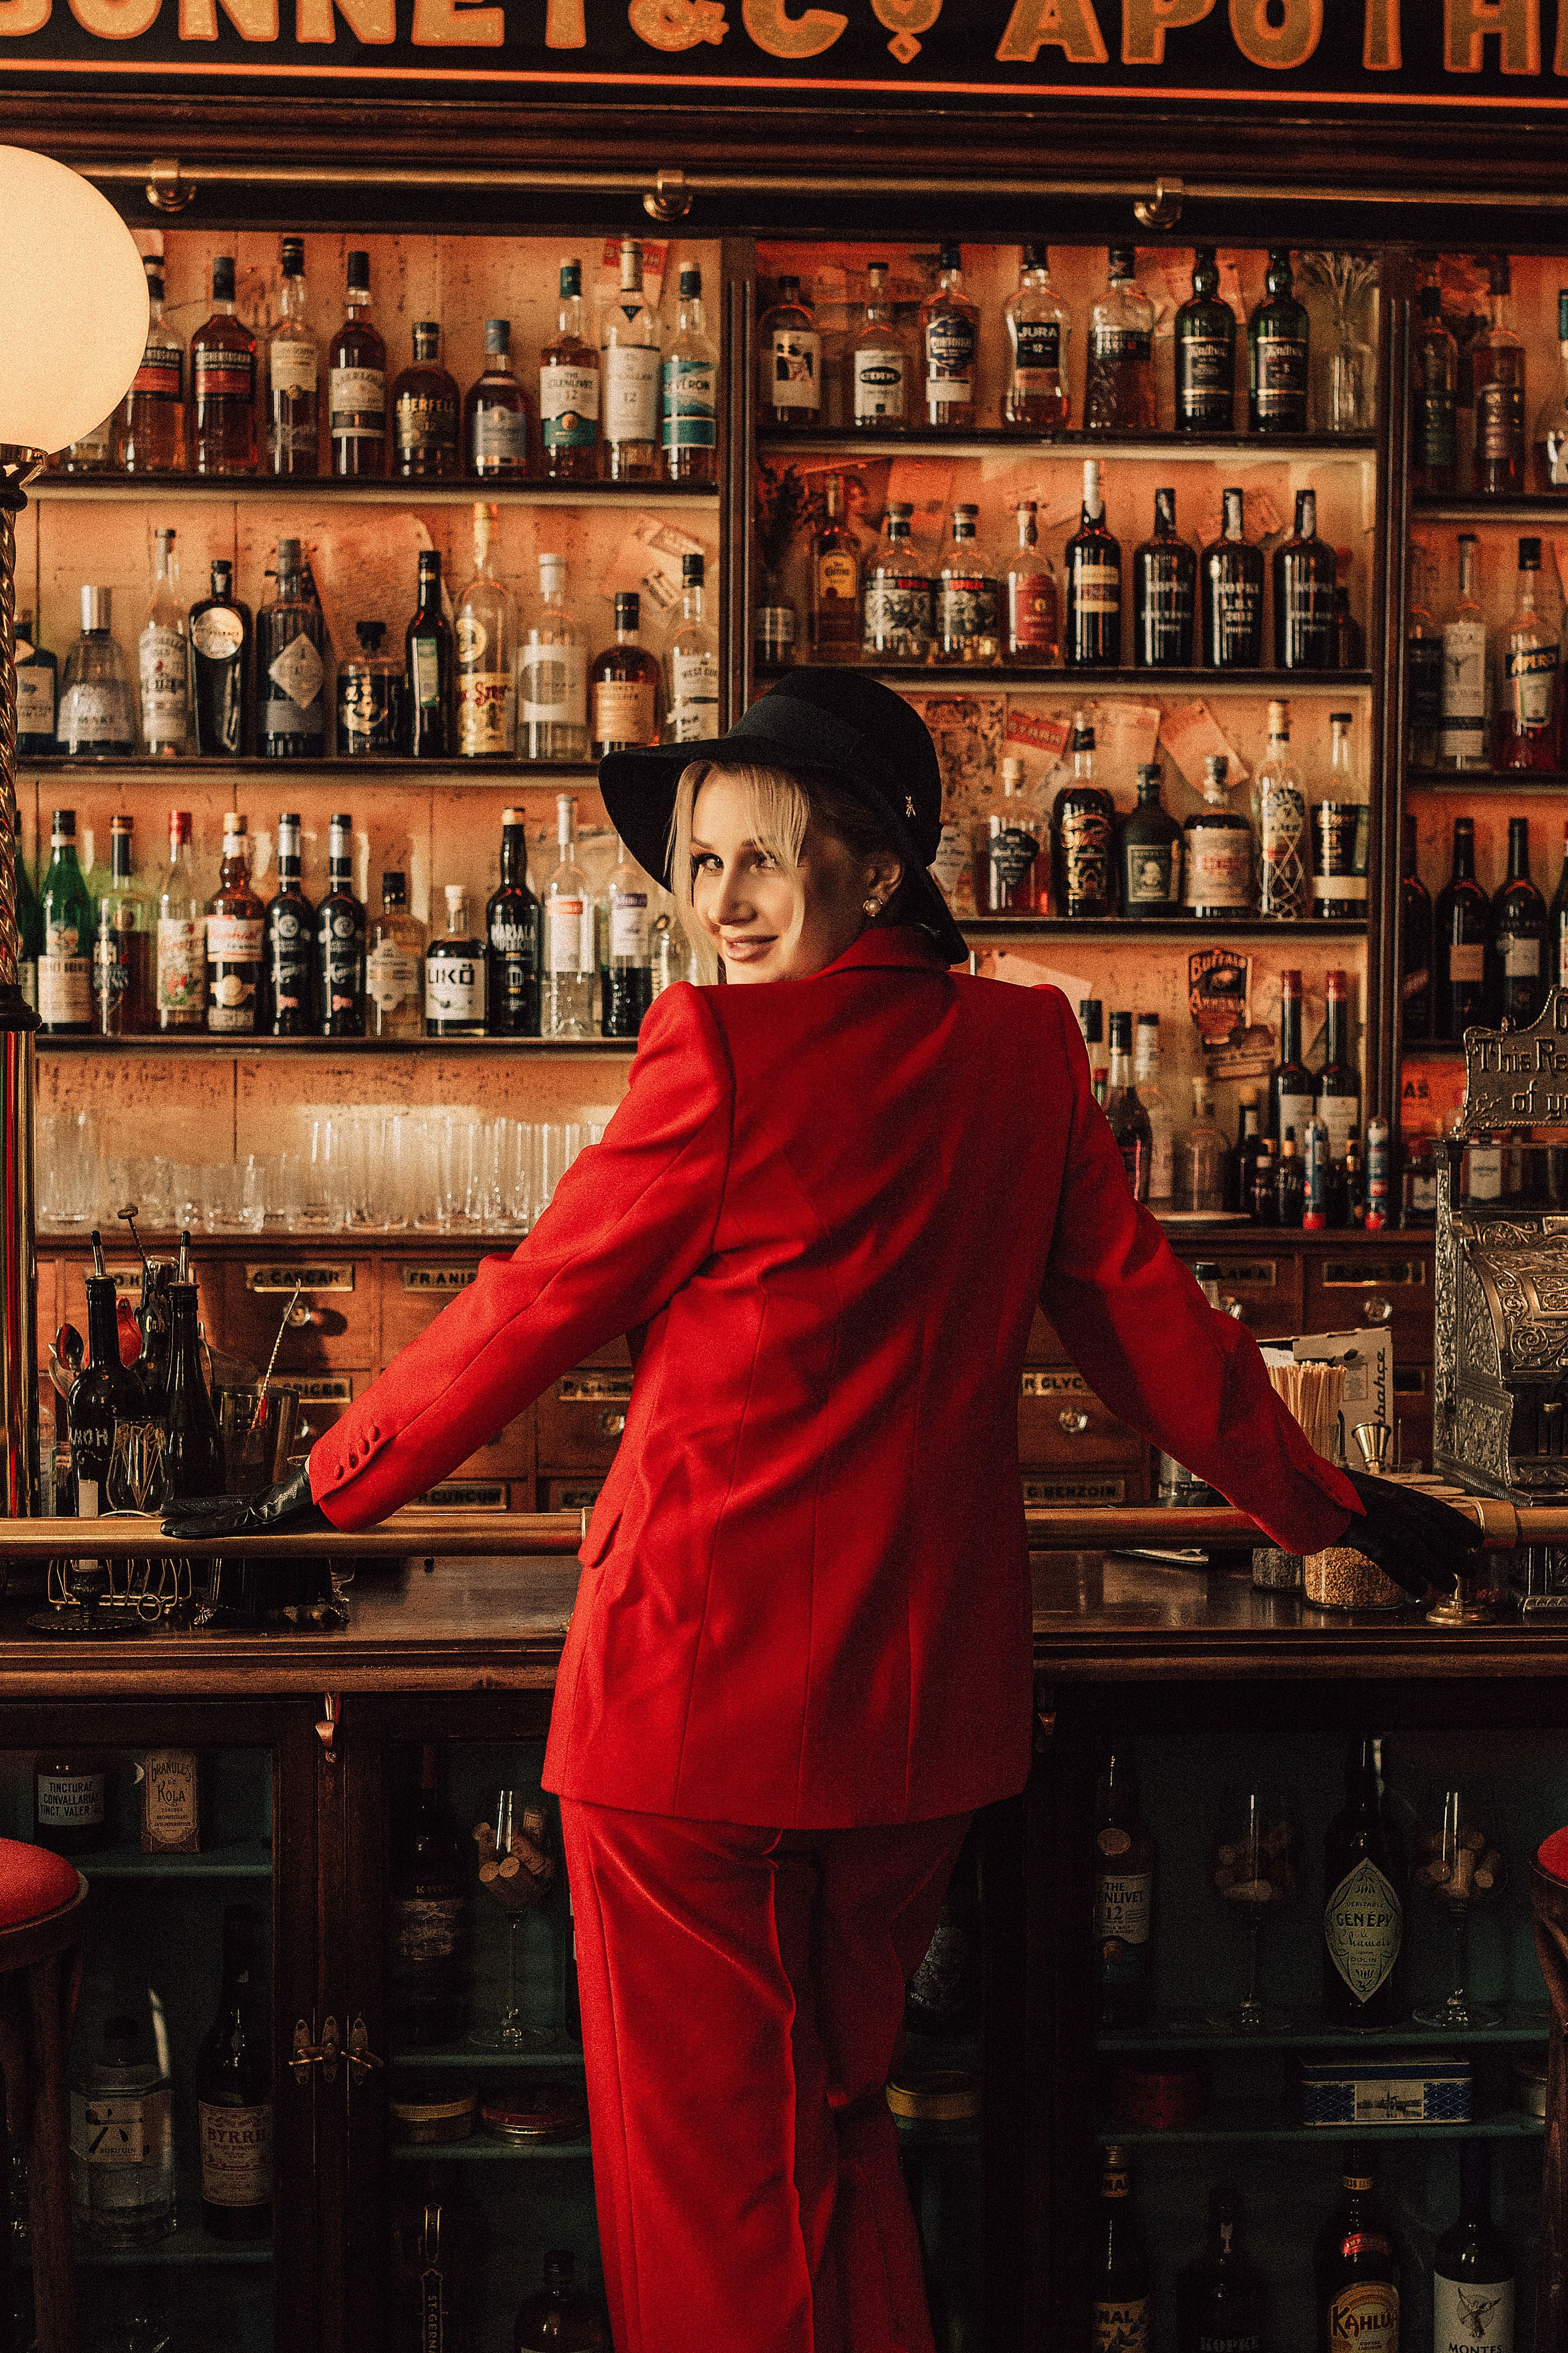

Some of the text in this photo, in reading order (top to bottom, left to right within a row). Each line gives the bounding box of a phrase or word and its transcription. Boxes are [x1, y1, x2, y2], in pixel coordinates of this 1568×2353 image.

[1018, 326, 1058, 338] JURA
[1472, 1037, 1531, 1074] This
[1511, 1079, 1538, 1114] of
[157, 1780, 186, 1807] KOLA
[1104, 1881, 1125, 1891] THE
[1106, 1906, 1123, 1920] 12
[208, 2126, 266, 2144] BYRRH
